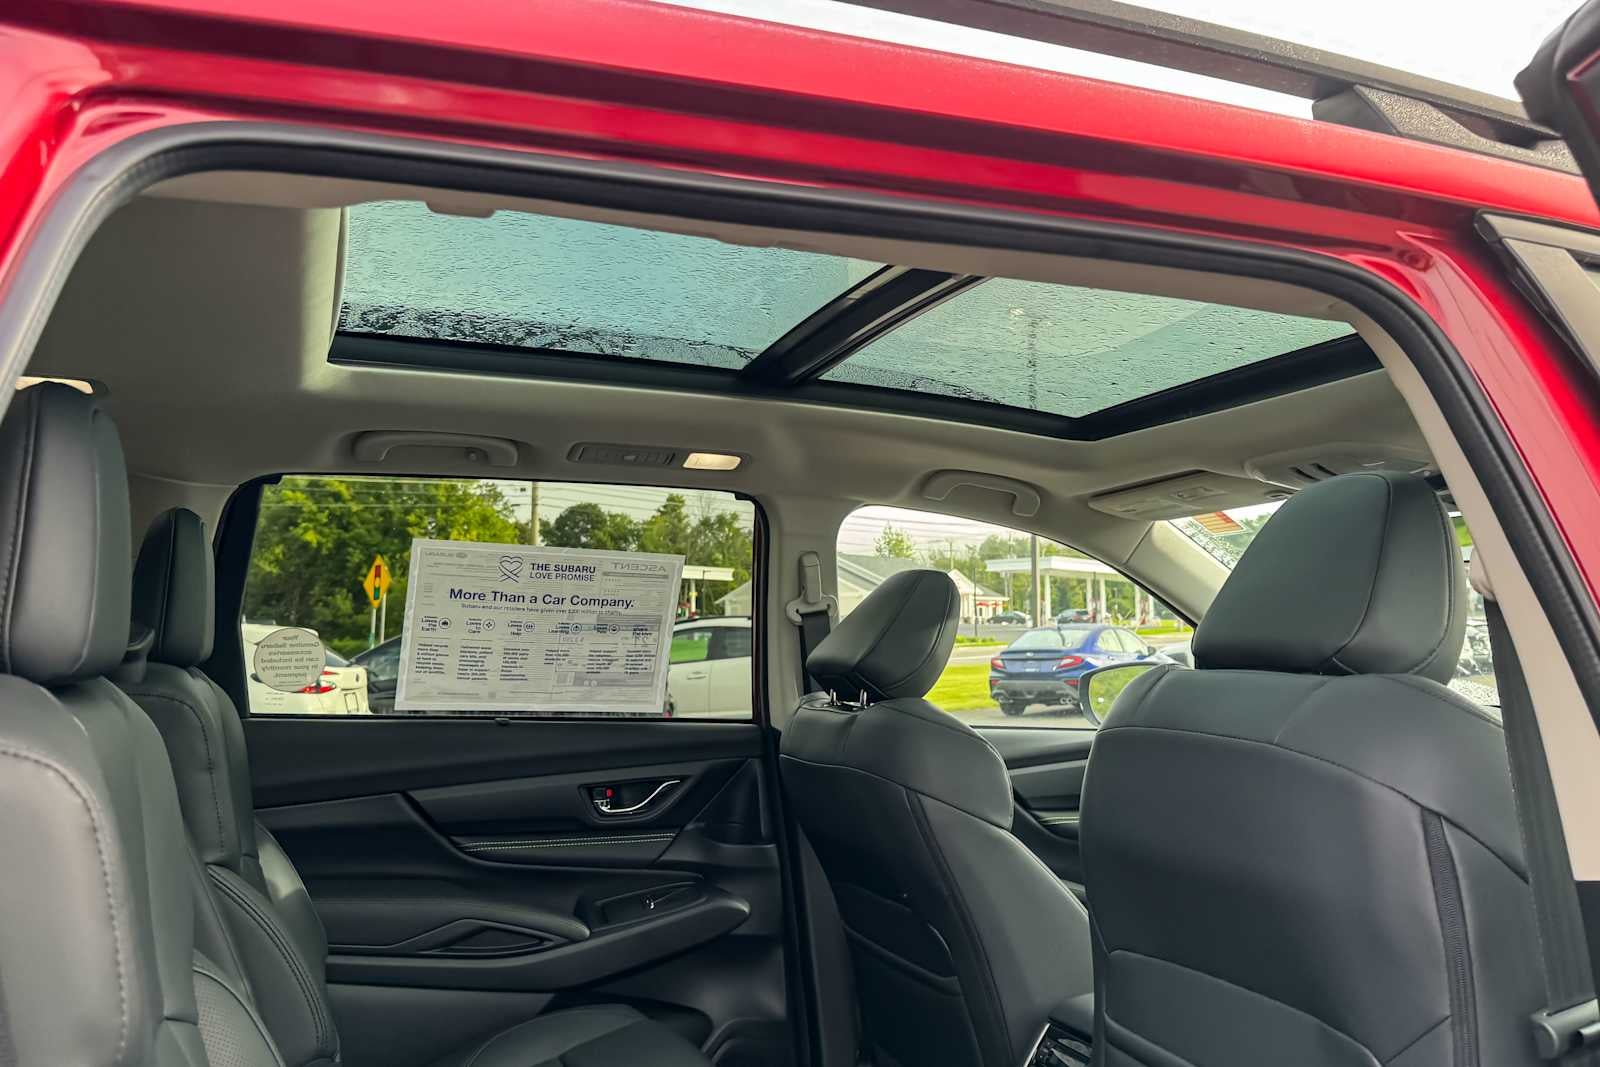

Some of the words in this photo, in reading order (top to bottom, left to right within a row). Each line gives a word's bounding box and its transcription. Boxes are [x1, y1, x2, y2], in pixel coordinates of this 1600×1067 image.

[530, 563, 550, 572] THE
[553, 563, 596, 574] SUBARU
[529, 572, 553, 580] LOVE
[555, 573, 595, 582] PROMISE
[449, 588, 486, 601] More
[491, 591, 525, 603] Than
[529, 595, 538, 604] a
[542, 594, 566, 606] Car
[570, 595, 635, 610] Company.
